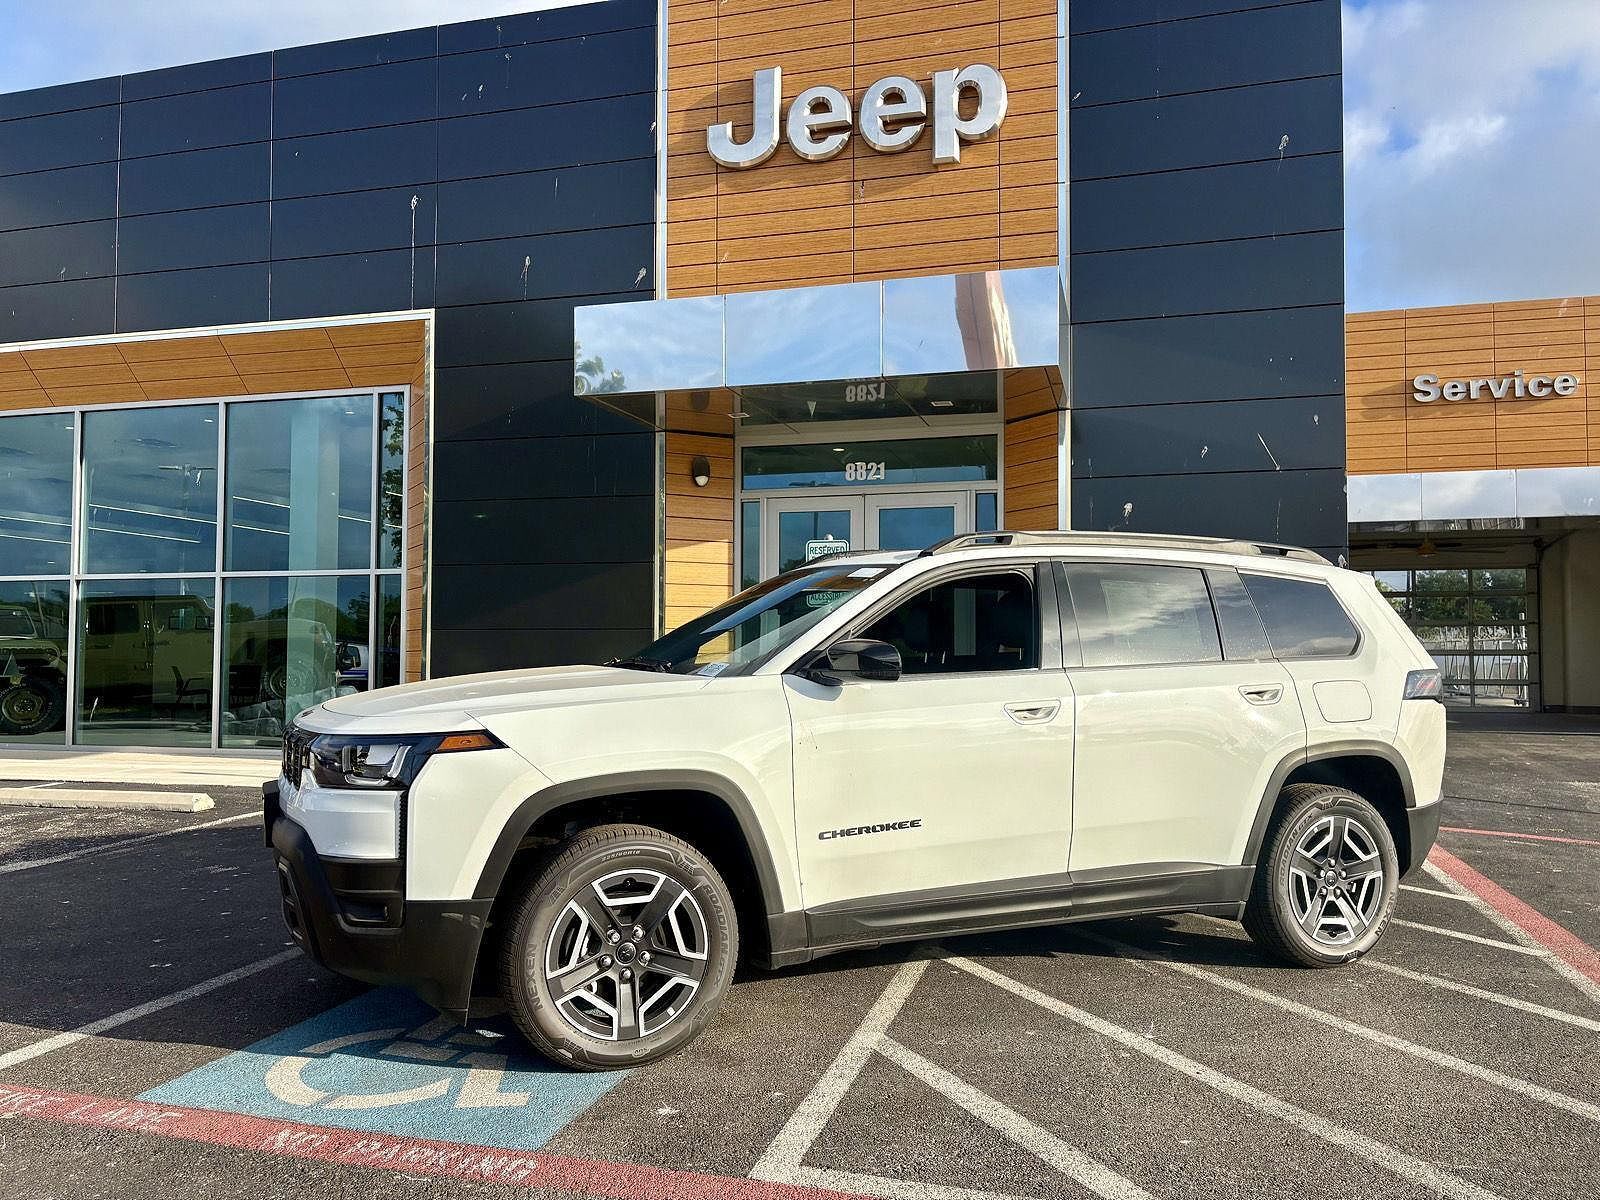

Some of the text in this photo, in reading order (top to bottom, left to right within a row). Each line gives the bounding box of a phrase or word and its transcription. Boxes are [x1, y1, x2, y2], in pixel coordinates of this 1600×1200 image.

[706, 63, 1008, 168] Jeep
[1413, 369, 1579, 403] Service
[845, 461, 886, 481] 8821
[810, 545, 845, 555] RESERVED
[818, 819, 922, 840] CHEROKEE
[1375, 891, 1395, 937] NEXEN
[525, 943, 544, 1010] NEXEN
[0, 1088, 66, 1115] IRE
[263, 1128, 537, 1182] NO PARKING
